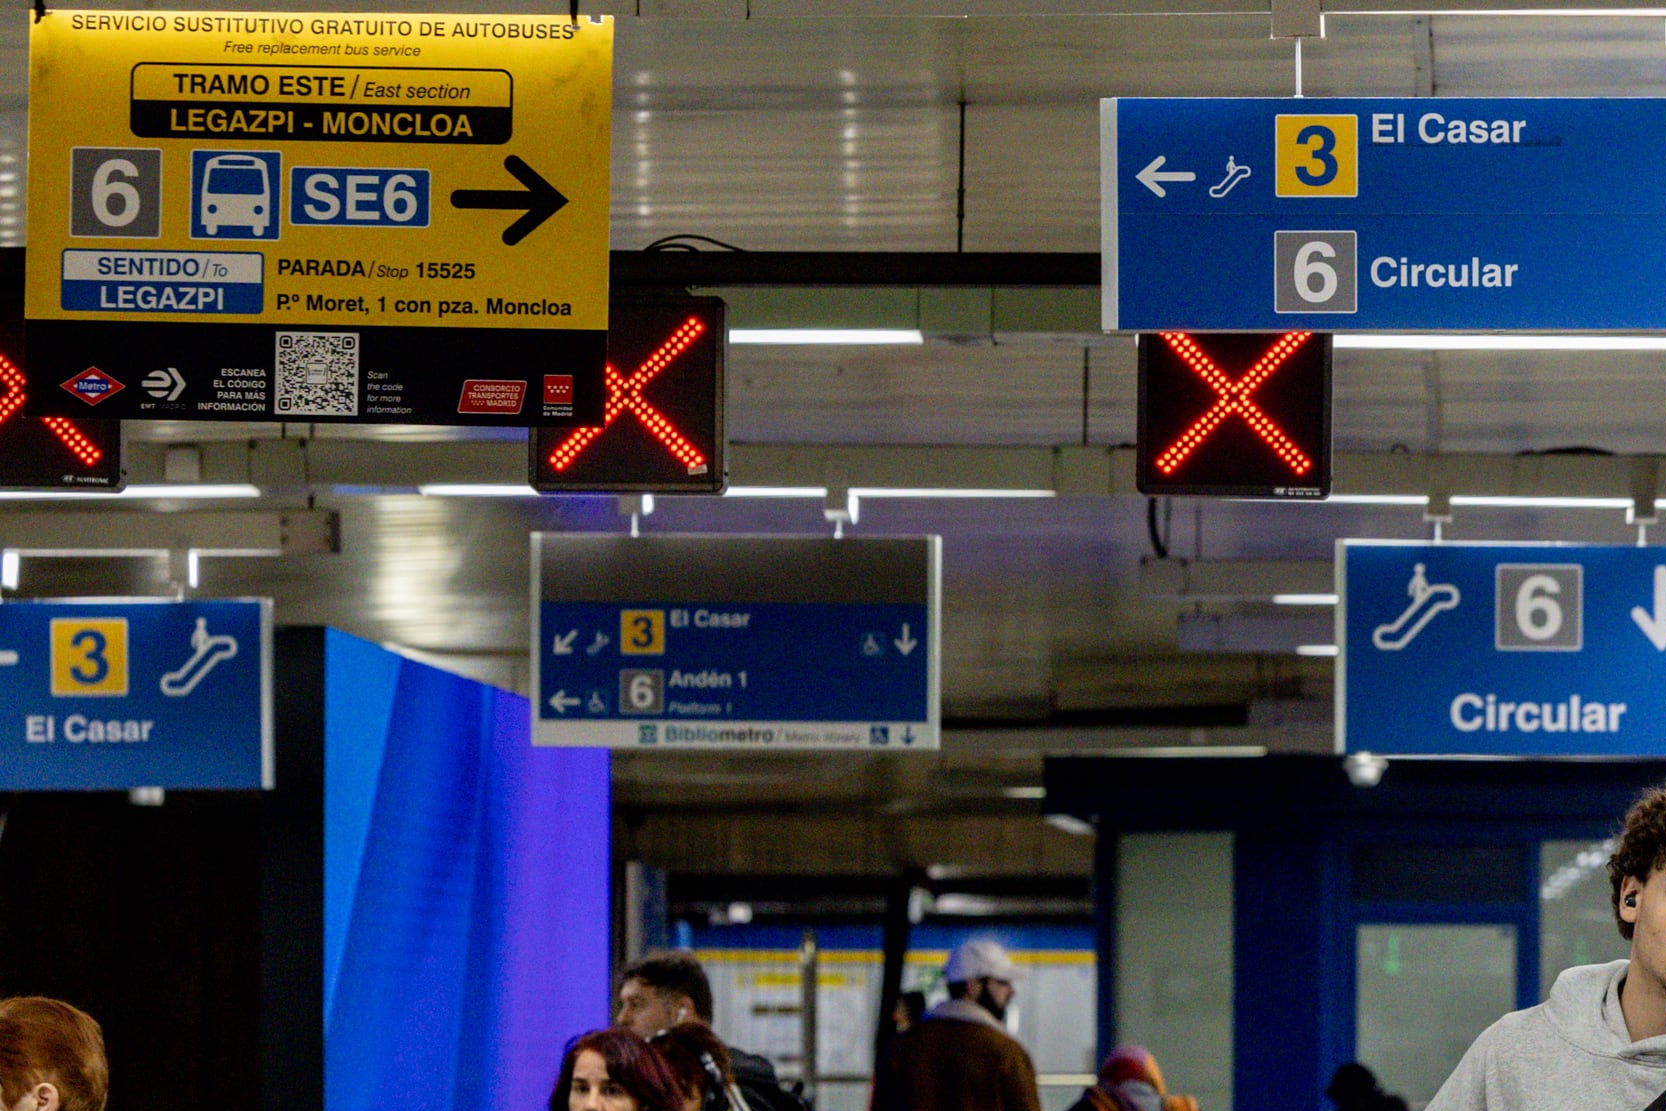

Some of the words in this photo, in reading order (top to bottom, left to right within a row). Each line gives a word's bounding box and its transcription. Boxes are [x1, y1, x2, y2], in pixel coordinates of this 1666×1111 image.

[72, 15, 166, 31] SERVICIO
[173, 16, 304, 34] SUSTITUTIVO
[311, 19, 412, 36] GRATUITO
[419, 22, 445, 37] DE
[453, 21, 575, 41] AUTOBUSES
[223, 41, 254, 53] Free
[257, 42, 341, 56] replacement
[344, 44, 369, 56] bus
[372, 46, 421, 57] service
[173, 73, 269, 95] TRAMO
[406, 83, 471, 100] section
[171, 108, 294, 133] LEGAZPI
[323, 111, 473, 137] MONCLOA
[1372, 113, 1404, 143] El
[1418, 113, 1526, 144] Casar
[1295, 125, 1338, 187] 3
[91, 158, 140, 227] 6
[304, 173, 417, 222] SE6
[416, 262, 476, 279] 15525
[1294, 241, 1338, 303] 6
[1370, 256, 1518, 288] Circular
[100, 286, 224, 310] LEGAZPI
[306, 294, 369, 315] Moret,
[378, 296, 387, 313] 1
[394, 300, 431, 313] con
[438, 301, 479, 318] pza.
[486, 298, 571, 316] Moncloa
[213, 379, 226, 388] EL
[227, 378, 266, 389] CÓDIGO
[221, 368, 266, 377] ESCANEA
[367, 370, 388, 379] Scan
[77, 381, 108, 392] Metro
[217, 391, 243, 399] PARA
[245, 390, 266, 400] MÁS
[367, 383, 380, 391] the
[367, 394, 379, 402] for
[467, 392, 519, 400] TRANSPORTES
[473, 384, 521, 392] CONSORCIO
[198, 402, 266, 411] INFORMACIÓN
[366, 405, 412, 414] information
[670, 609, 689, 628] El
[694, 609, 750, 628] Casar
[1516, 575, 1562, 640] 6
[632, 616, 654, 648] 3
[70, 630, 109, 685] 3
[668, 669, 732, 688] Andén
[738, 671, 747, 688] 1
[630, 675, 654, 708] 6
[1450, 693, 1627, 733] Circular
[26, 716, 54, 742] El
[63, 715, 153, 743] Casar
[665, 725, 775, 744] Bibliometro
